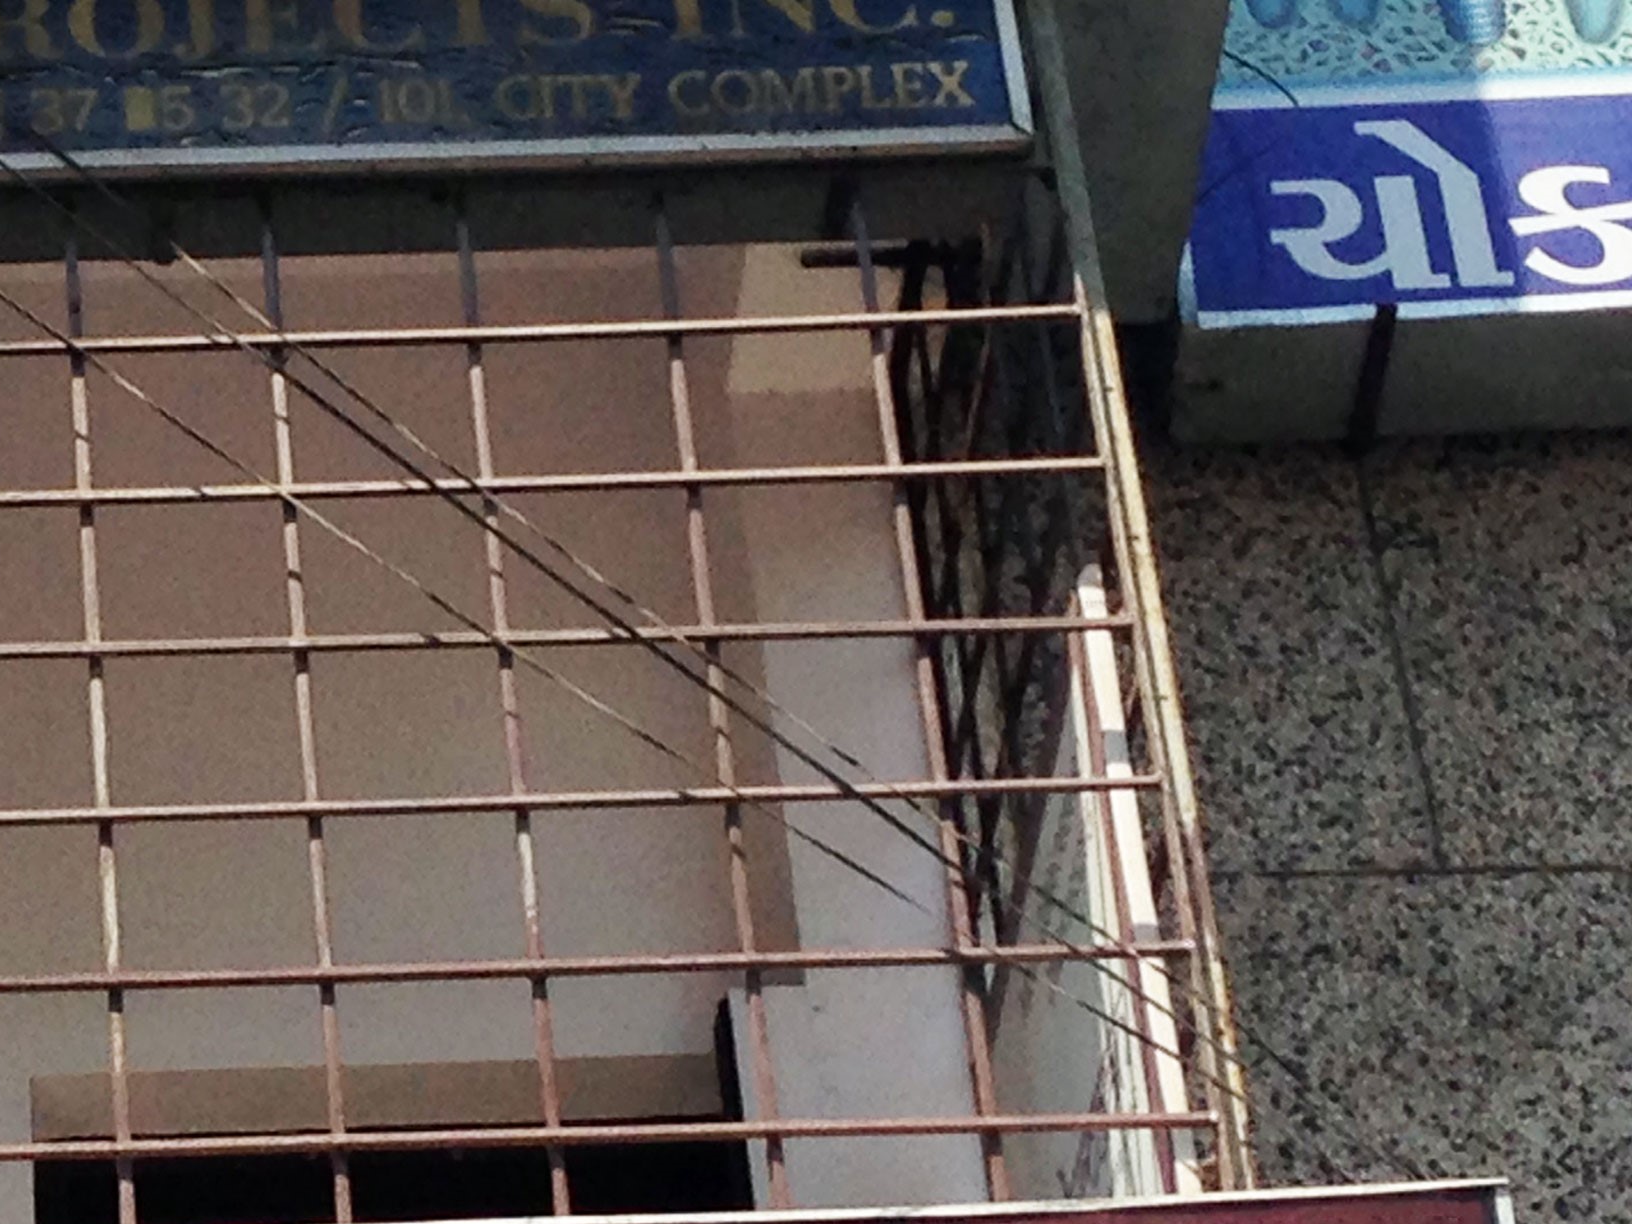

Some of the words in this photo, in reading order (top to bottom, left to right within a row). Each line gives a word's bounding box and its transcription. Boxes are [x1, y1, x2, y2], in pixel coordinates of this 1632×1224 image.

[123, 85, 196, 132] 5
[497, 73, 642, 120] CITY
[668, 60, 976, 118] COMPLEX
